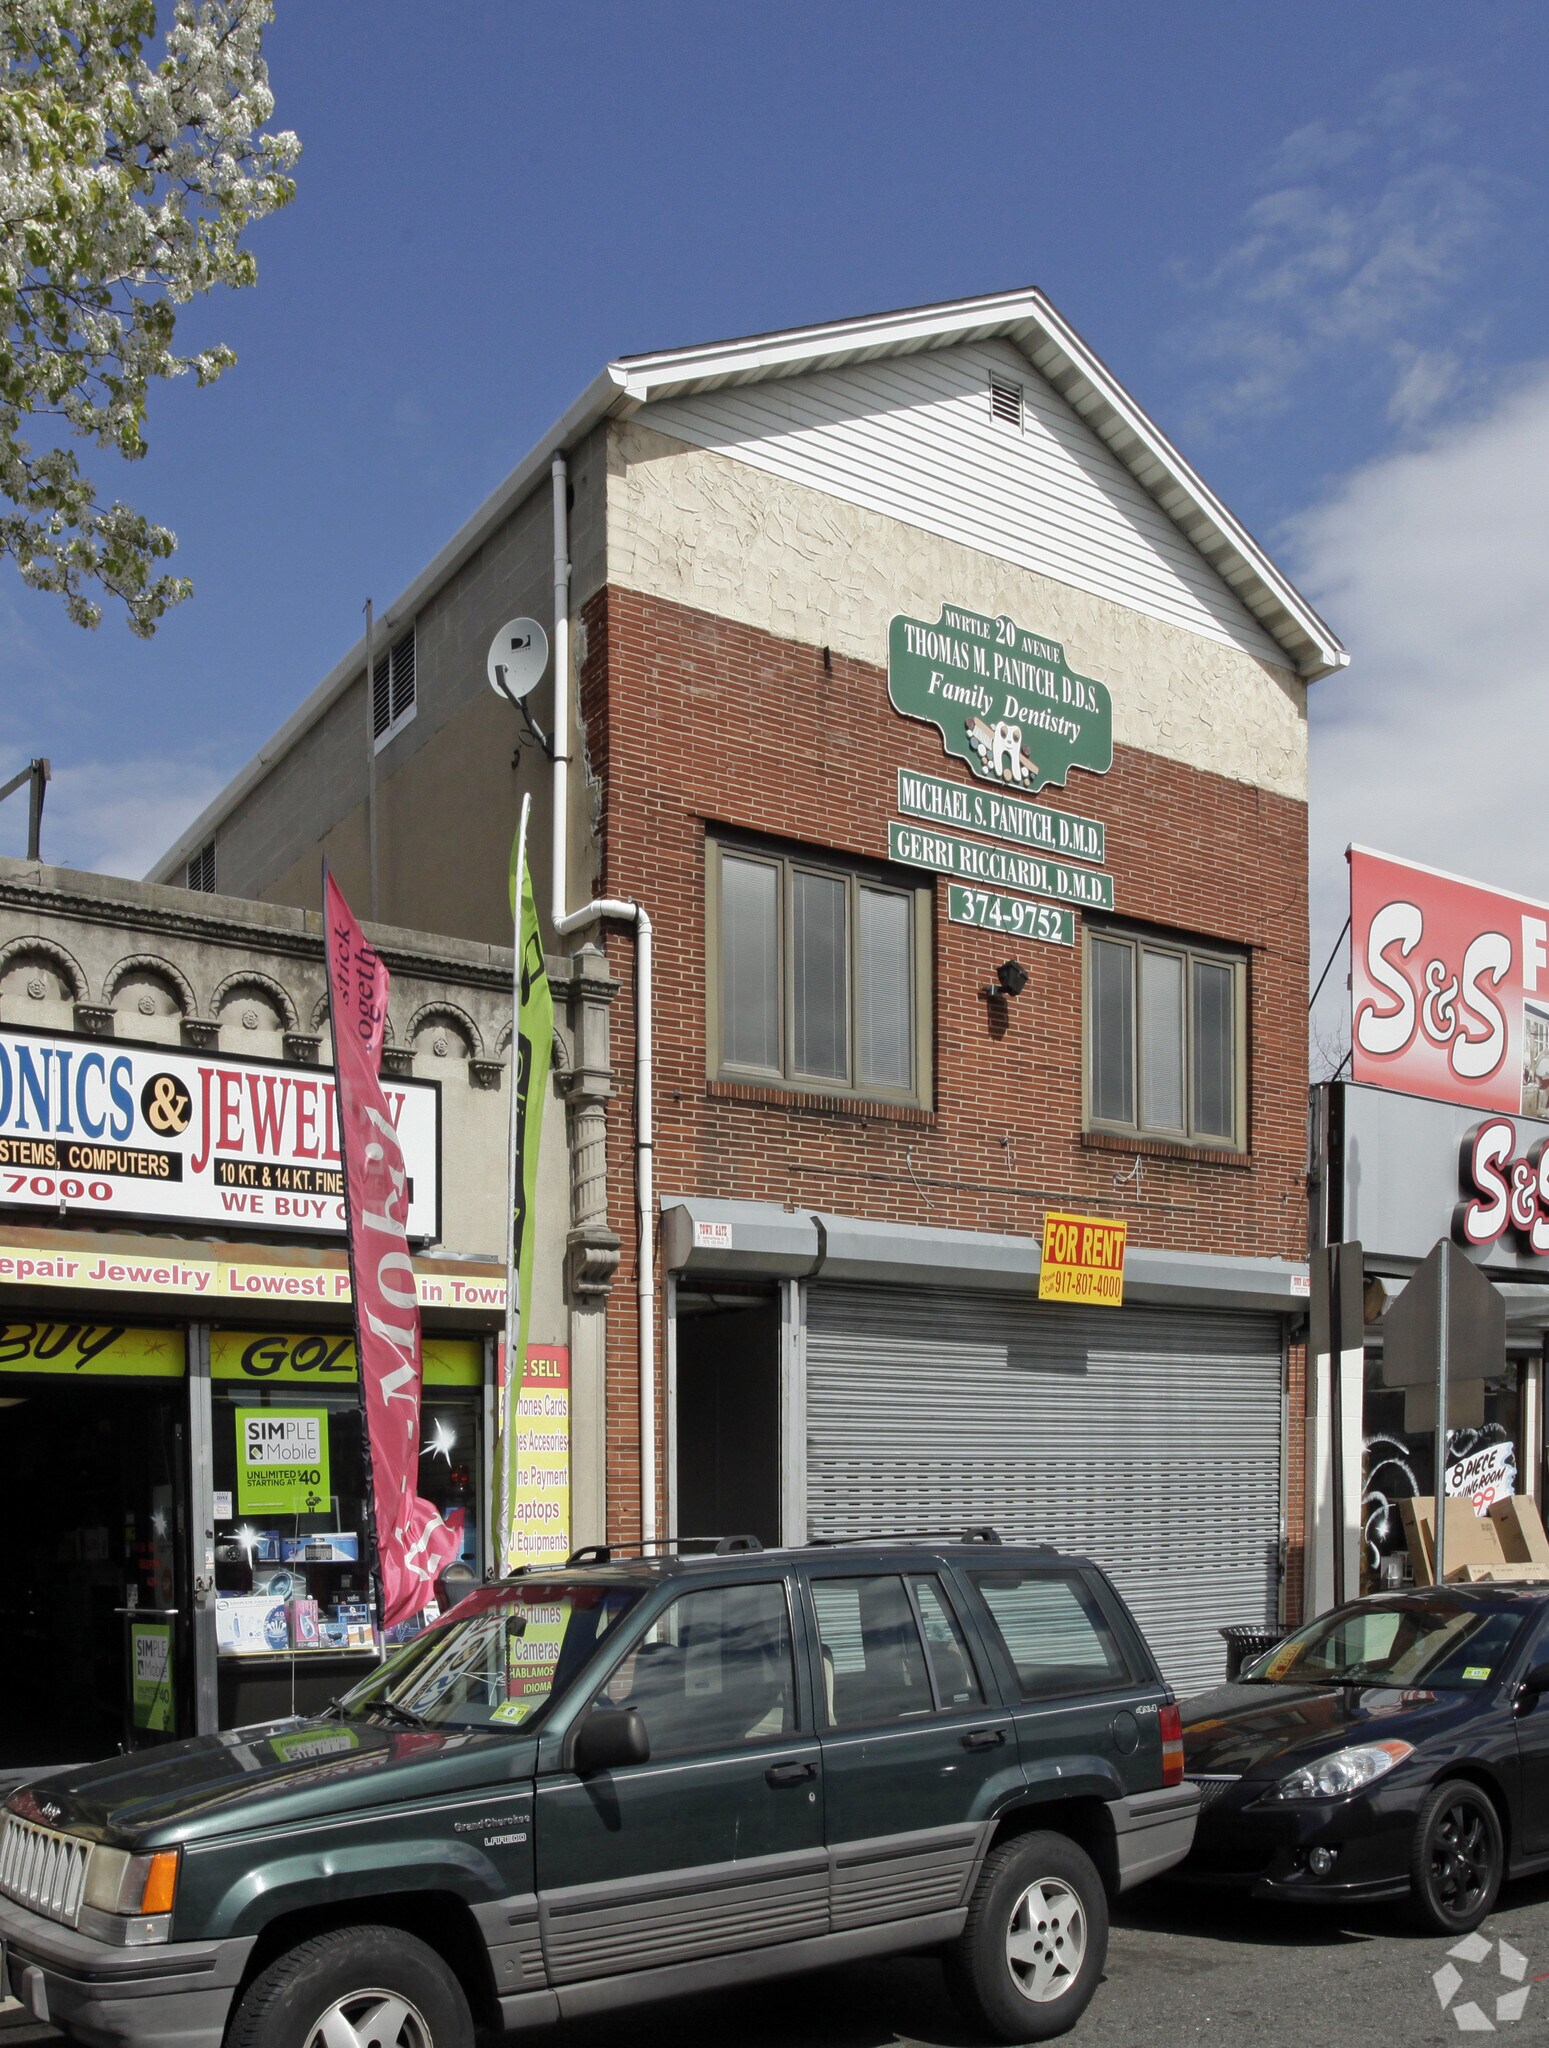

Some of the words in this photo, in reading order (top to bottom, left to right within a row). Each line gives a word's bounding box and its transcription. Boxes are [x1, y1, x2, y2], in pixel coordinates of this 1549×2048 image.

[945, 610, 990, 639] MYRTLE
[995, 619, 1016, 647] 20
[1021, 637, 1060, 663] AVENUE
[905, 624, 969, 670] THOMAS
[973, 653, 990, 677] M.
[994, 654, 1059, 701] PANITCH,
[1062, 677, 1099, 713] D.D.S.
[928, 671, 993, 717] Family
[1003, 696, 1080, 744] Dentistry
[902, 777, 971, 823] MICHAEL
[975, 797, 986, 825] S.
[991, 803, 1056, 847] PANITCH,
[1060, 826, 1101, 856] D.M.D.
[898, 831, 953, 867] GERRI
[960, 845, 1052, 892] RICCIARDI,
[1057, 871, 1106, 903] D.M.D.
[962, 891, 1062, 940] 374-9752
[334, 919, 350, 1005] stick
[1358, 900, 1512, 1078] S&S
[149, 1077, 189, 1133] &
[191, 1067, 405, 1174] JEWELY
[69, 1147, 169, 1176] COMPUTERS
[3, 1174, 112, 1201] 7000
[221, 1163, 234, 1183] 10
[239, 1165, 258, 1185] KT.
[262, 1169, 271, 1187] &
[275, 1169, 289, 1188] 14
[293, 1172, 312, 1191] KT.
[316, 1175, 344, 1194] FINE
[221, 1192, 264, 1213] WE
[275, 1197, 327, 1218] BUY
[1045, 1223, 1078, 1263] FOR
[1082, 1227, 1124, 1267] RENT
[0, 1257, 79, 1280] epair
[89, 1260, 210, 1291] Jewelry
[230, 1269, 326, 1296] Lowest
[1056, 1271, 1120, 1297] 917-807-4000
[422, 1280, 443, 1300] in
[241, 1337, 356, 1376] GOL
[531, 1360, 561, 1377] SELL
[545, 1394, 567, 1416] Cards
[248, 1422, 316, 1440] SIMPLE
[529, 1430, 567, 1451] Accesories
[267, 1444, 316, 1460] Mobile
[247, 1470, 296, 1479] UNLIMITED
[531, 1466, 567, 1490] Payment
[1452, 1463, 1464, 1488] 8
[1464, 1450, 1497, 1480] PIECE
[247, 1479, 285, 1487] STARTING
[513, 1500, 559, 1523] aptops
[518, 1532, 568, 1555] Equipments
[137, 1640, 167, 1658] SIMPLE
[515, 1638, 559, 1660] Cameras
[510, 1666, 554, 1679] HABLAMOS
[484, 1833, 527, 1847] LAREDO
